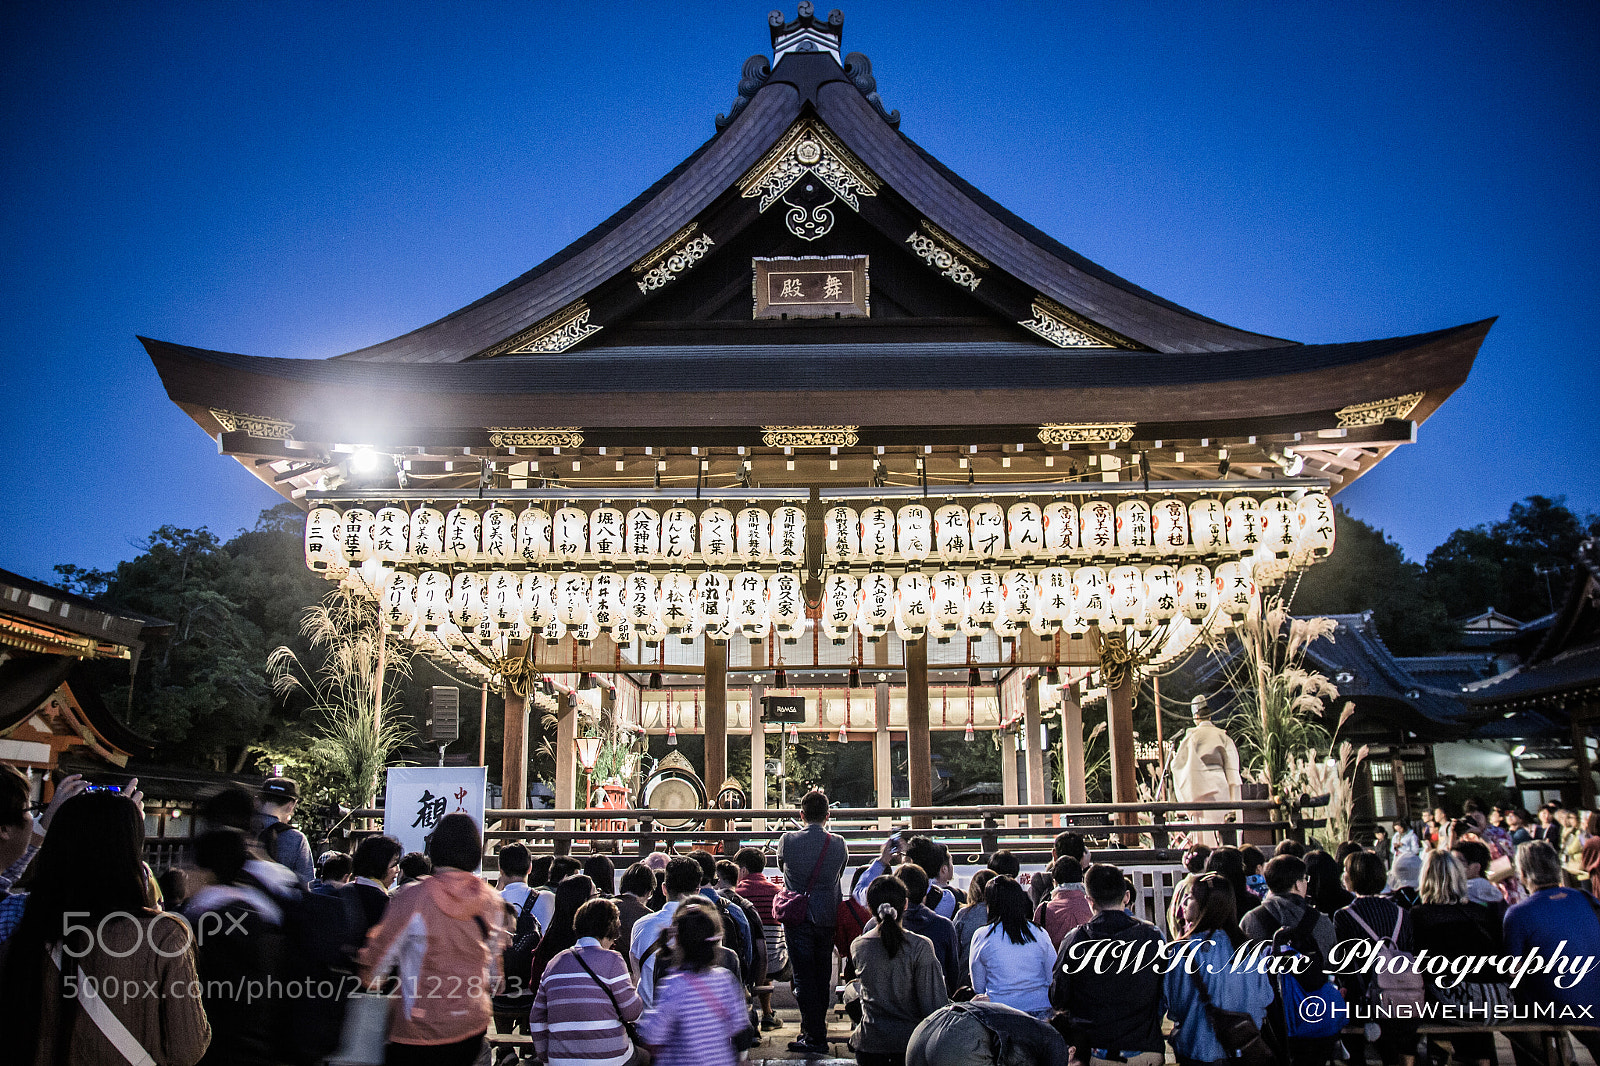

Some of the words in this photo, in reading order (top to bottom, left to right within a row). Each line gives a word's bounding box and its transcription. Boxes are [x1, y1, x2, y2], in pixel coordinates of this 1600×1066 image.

[448, 510, 466, 557] たまや
[634, 511, 652, 554] 八坂神社
[1130, 502, 1148, 546] 八坂神社
[776, 705, 797, 713] RAMSA
